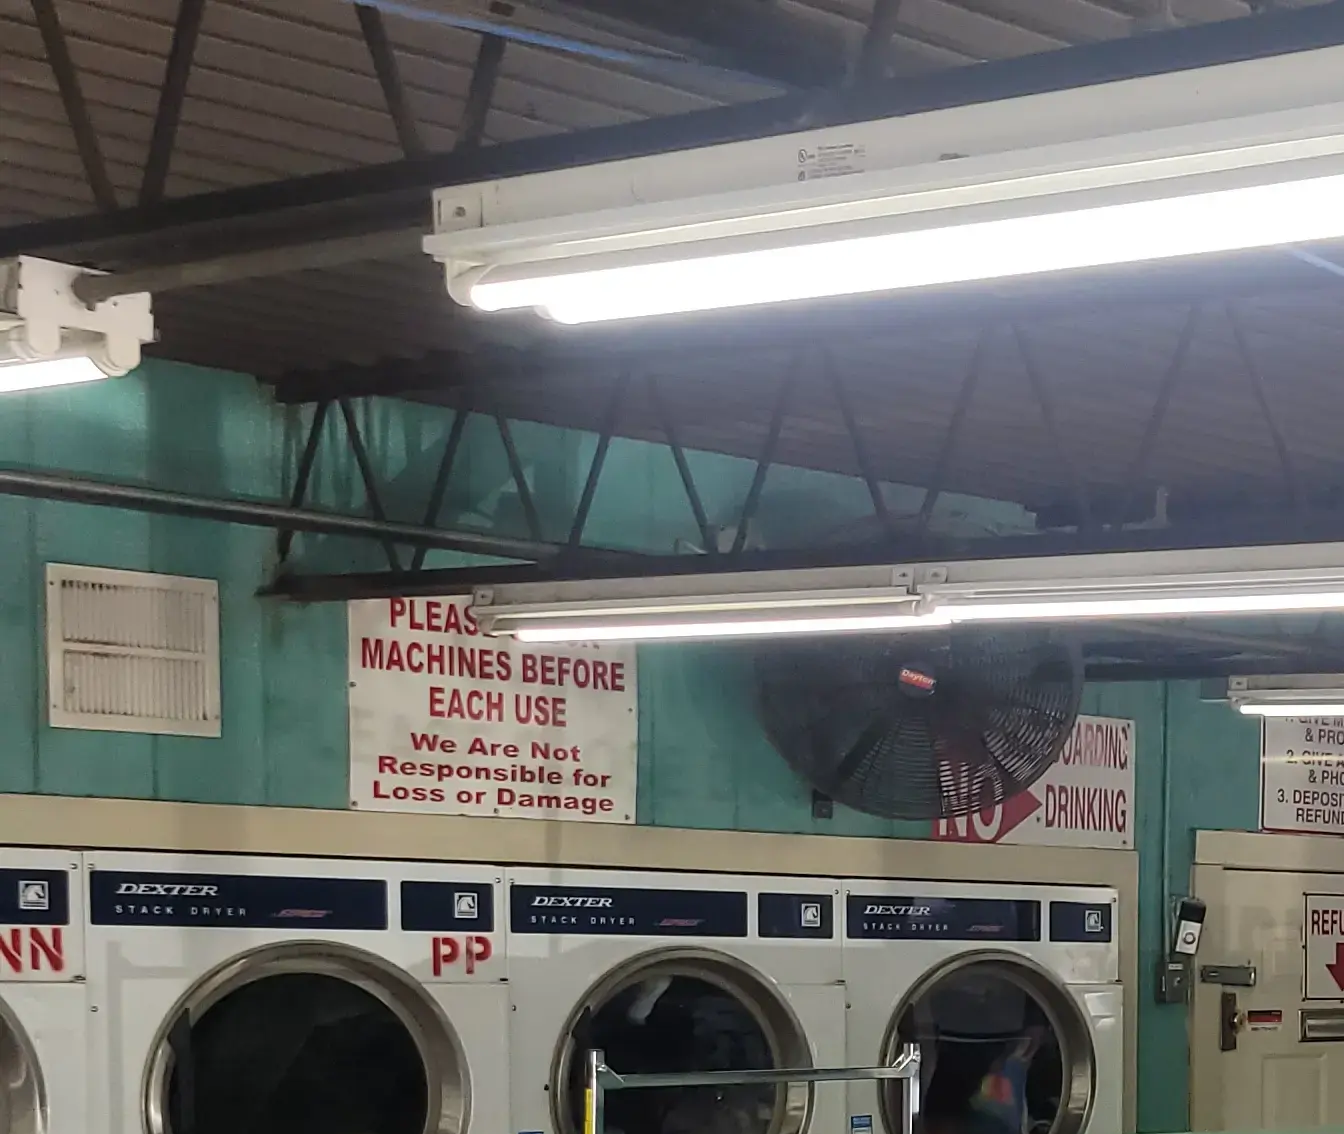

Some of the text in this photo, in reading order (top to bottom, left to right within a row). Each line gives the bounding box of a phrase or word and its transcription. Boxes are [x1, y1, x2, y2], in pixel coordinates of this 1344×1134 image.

[390, 597, 498, 638] PLEAS
[361, 637, 625, 692] MACHINES BEFORE
[901, 669, 936, 686] Dayton
[429, 686, 567, 727] EACH USE
[1305, 728, 1313, 742] &
[410, 732, 581, 762] We Are Not
[378, 755, 612, 788] Responsible for
[1309, 770, 1316, 783] &
[373, 780, 615, 815] Loss or Damage
[1277, 789, 1288, 803] 3.
[1045, 784, 1127, 833] DRINKING
[115, 883, 218, 896] DEXTER
[115, 904, 247, 917] STACK DRYER
[531, 896, 613, 908] DEXTER
[863, 905, 931, 916] DEXTER
[531, 915, 636, 926] STACK DRYER
[432, 936, 492, 977] PP
